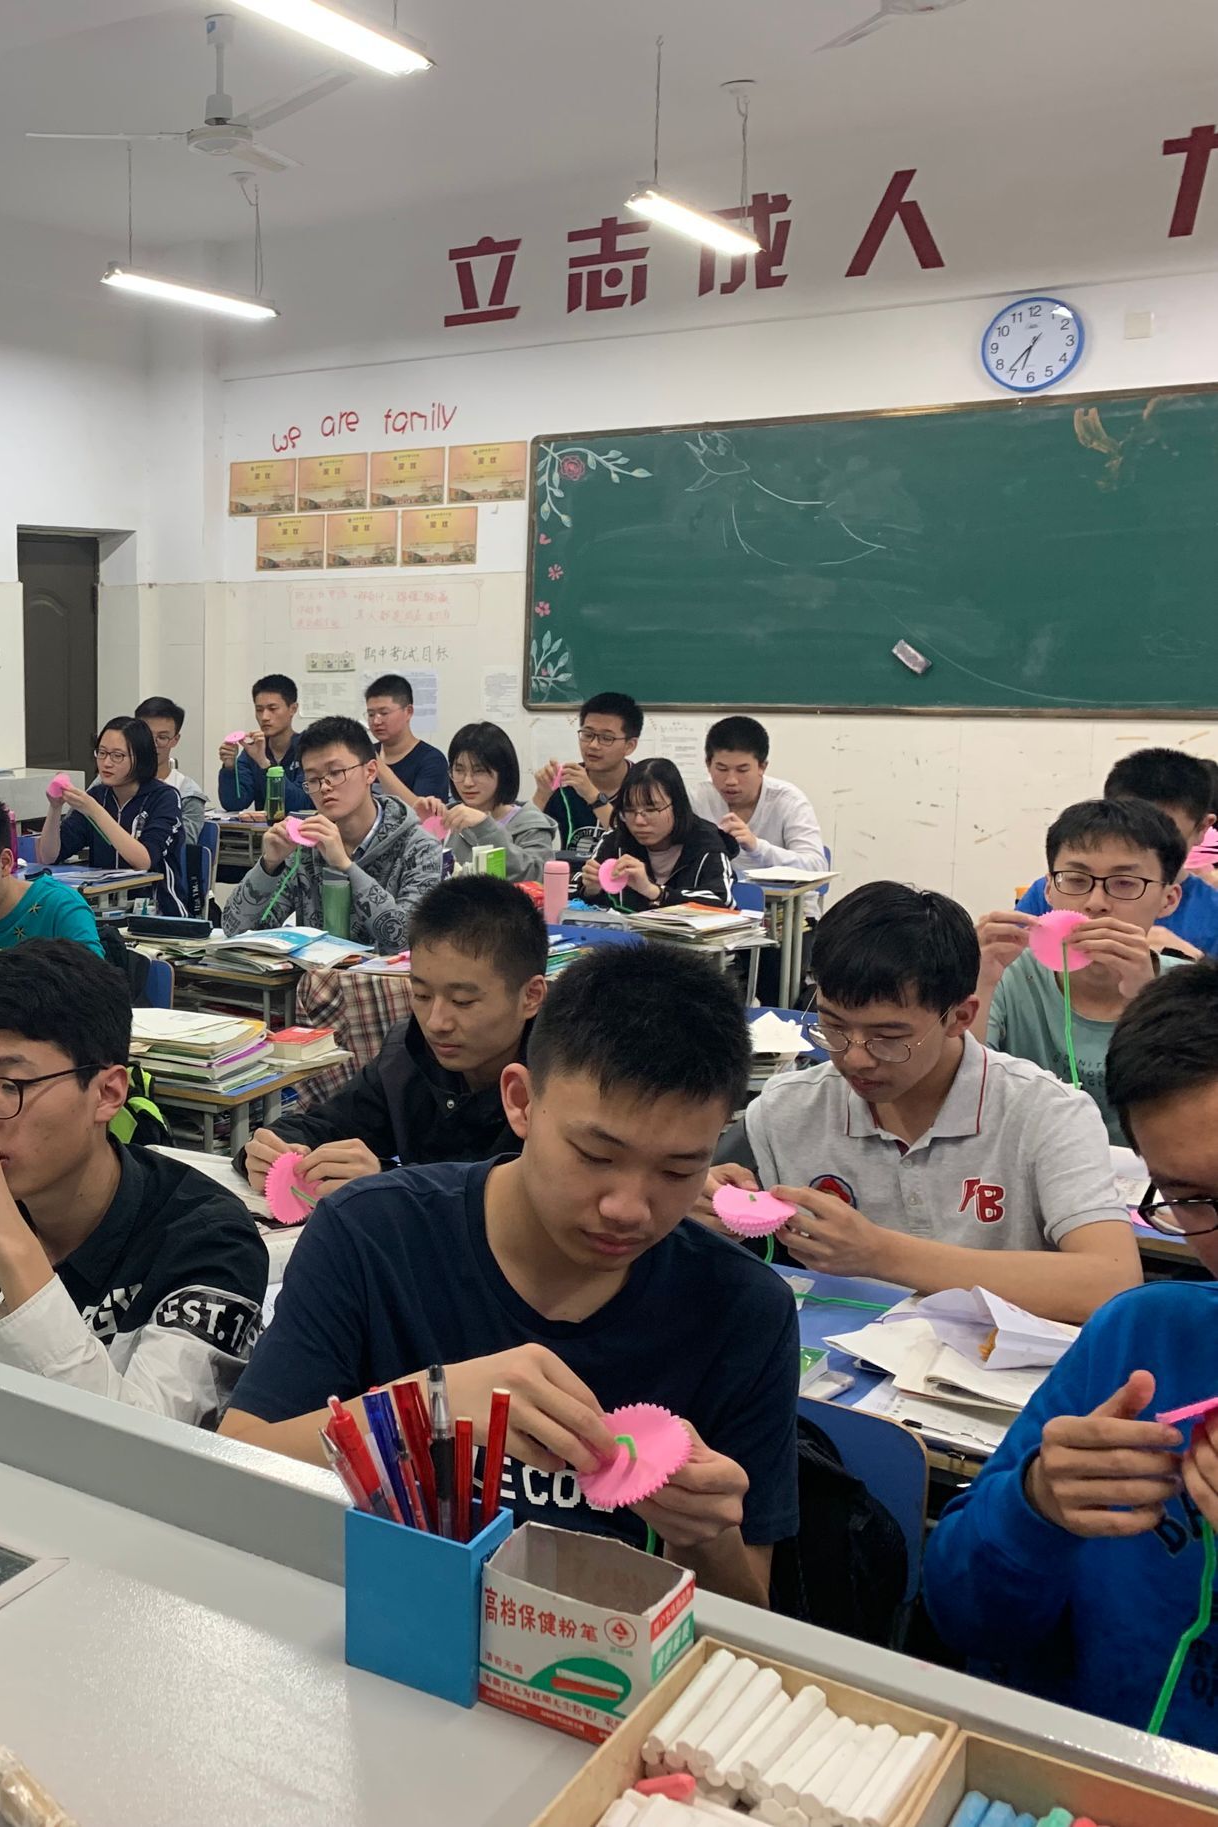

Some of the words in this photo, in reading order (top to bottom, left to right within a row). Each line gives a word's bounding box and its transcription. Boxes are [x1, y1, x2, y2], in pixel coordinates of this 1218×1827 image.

[444, 169, 946, 328] 立志成人
[1011, 311, 1023, 324] 11
[1028, 304, 1042, 318] 12
[996, 325, 1010, 338] 10
[320, 410, 360, 437] are
[384, 402, 458, 435] family
[484, 1585, 598, 1643] 高档保健粉笔
